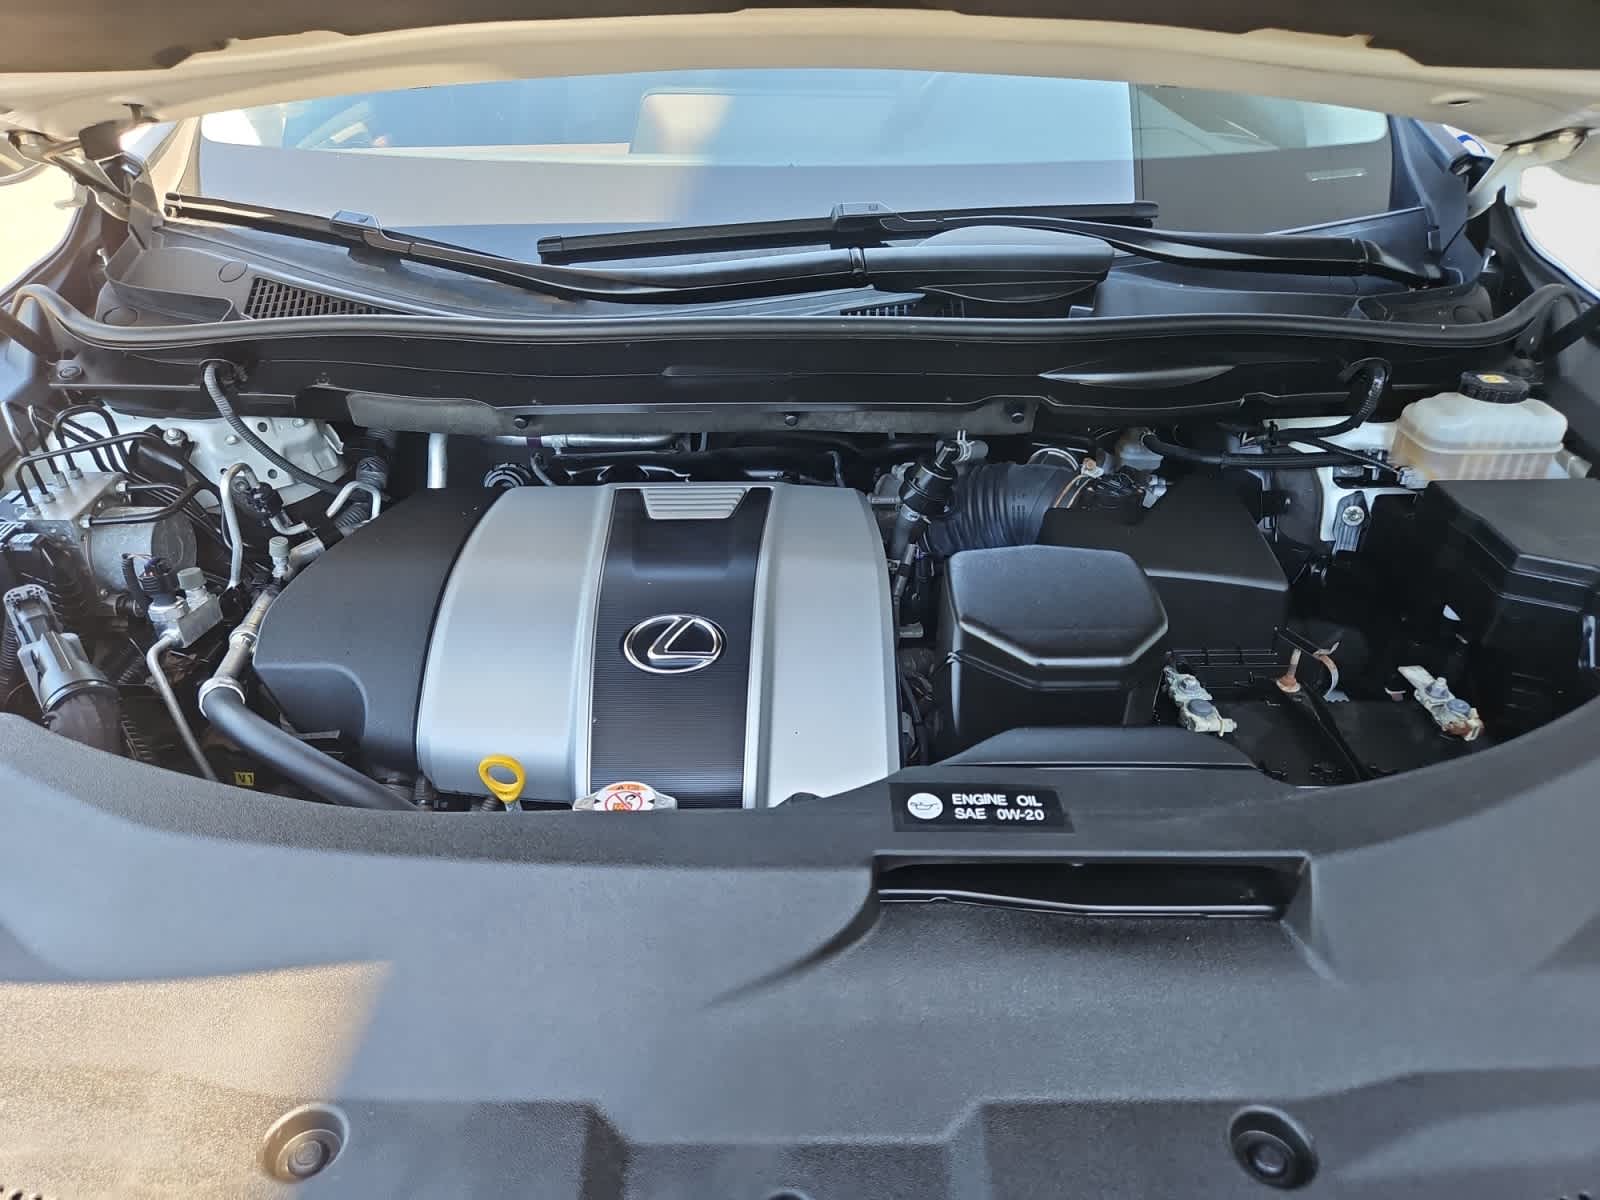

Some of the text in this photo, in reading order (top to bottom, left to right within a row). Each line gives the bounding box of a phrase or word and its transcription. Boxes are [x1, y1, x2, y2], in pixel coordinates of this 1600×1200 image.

[951, 793, 1043, 807] ENGINE OIL
[954, 807, 1045, 821] SAE 0W-20
